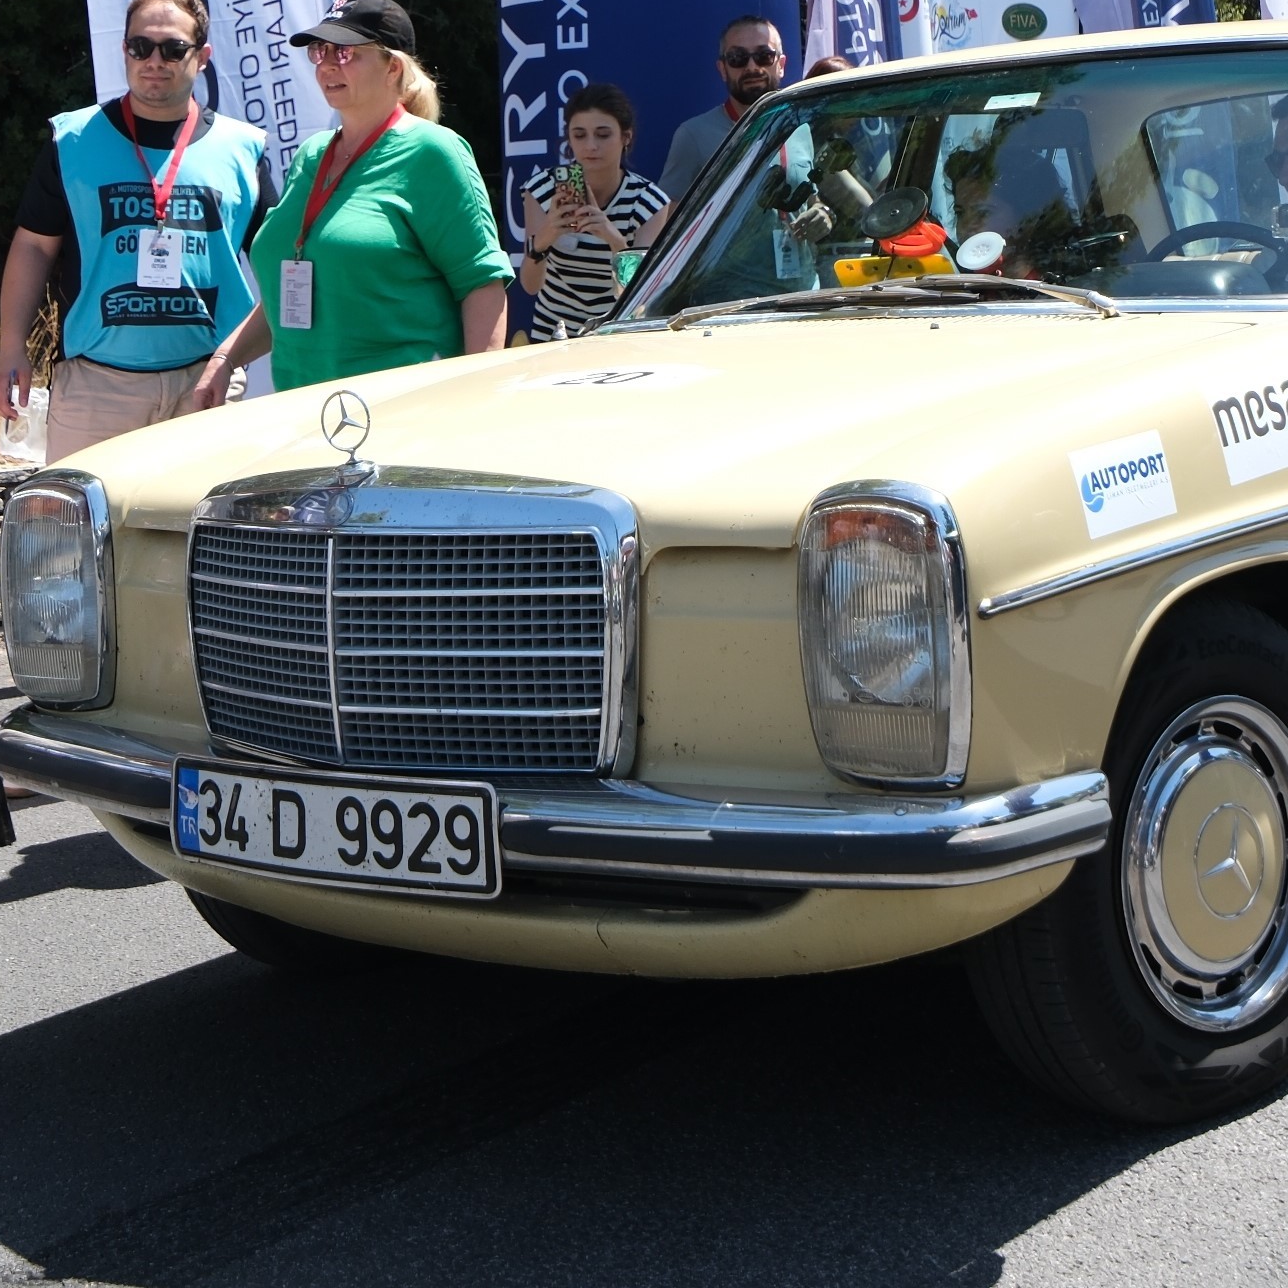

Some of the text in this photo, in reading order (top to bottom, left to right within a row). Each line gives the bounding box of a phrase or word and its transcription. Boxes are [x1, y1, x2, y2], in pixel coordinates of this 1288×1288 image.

[1009, 13, 1039, 28] FIVA
[1090, 452, 1165, 493] AUTOPORT
[179, 814, 198, 838] TR
[198, 779, 482, 877] 34 D 9929
